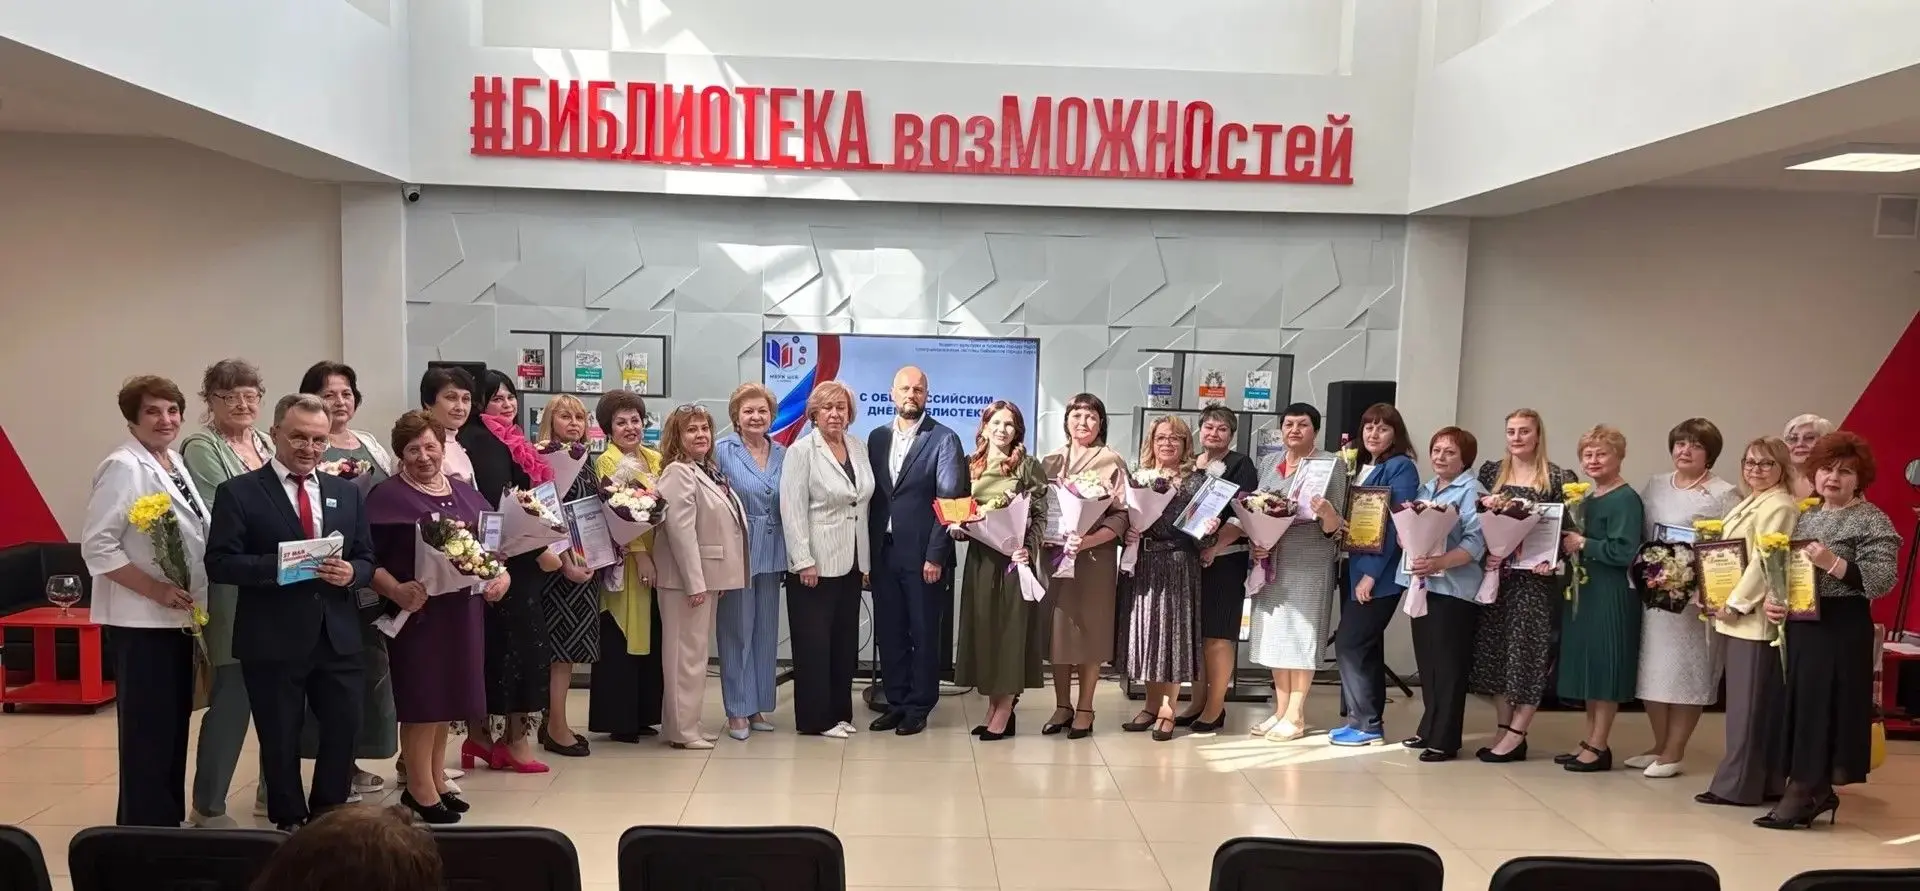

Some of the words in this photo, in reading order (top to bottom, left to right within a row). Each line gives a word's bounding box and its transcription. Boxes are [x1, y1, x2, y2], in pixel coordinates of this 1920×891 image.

[470, 75, 874, 167] #БИБЛИОТЕКА
[893, 95, 1355, 184] возМОЖНОстей
[859, 392, 868, 402] С
[871, 392, 994, 405] ОБССИЙСКИМ
[867, 406, 897, 416] ДНЕ
